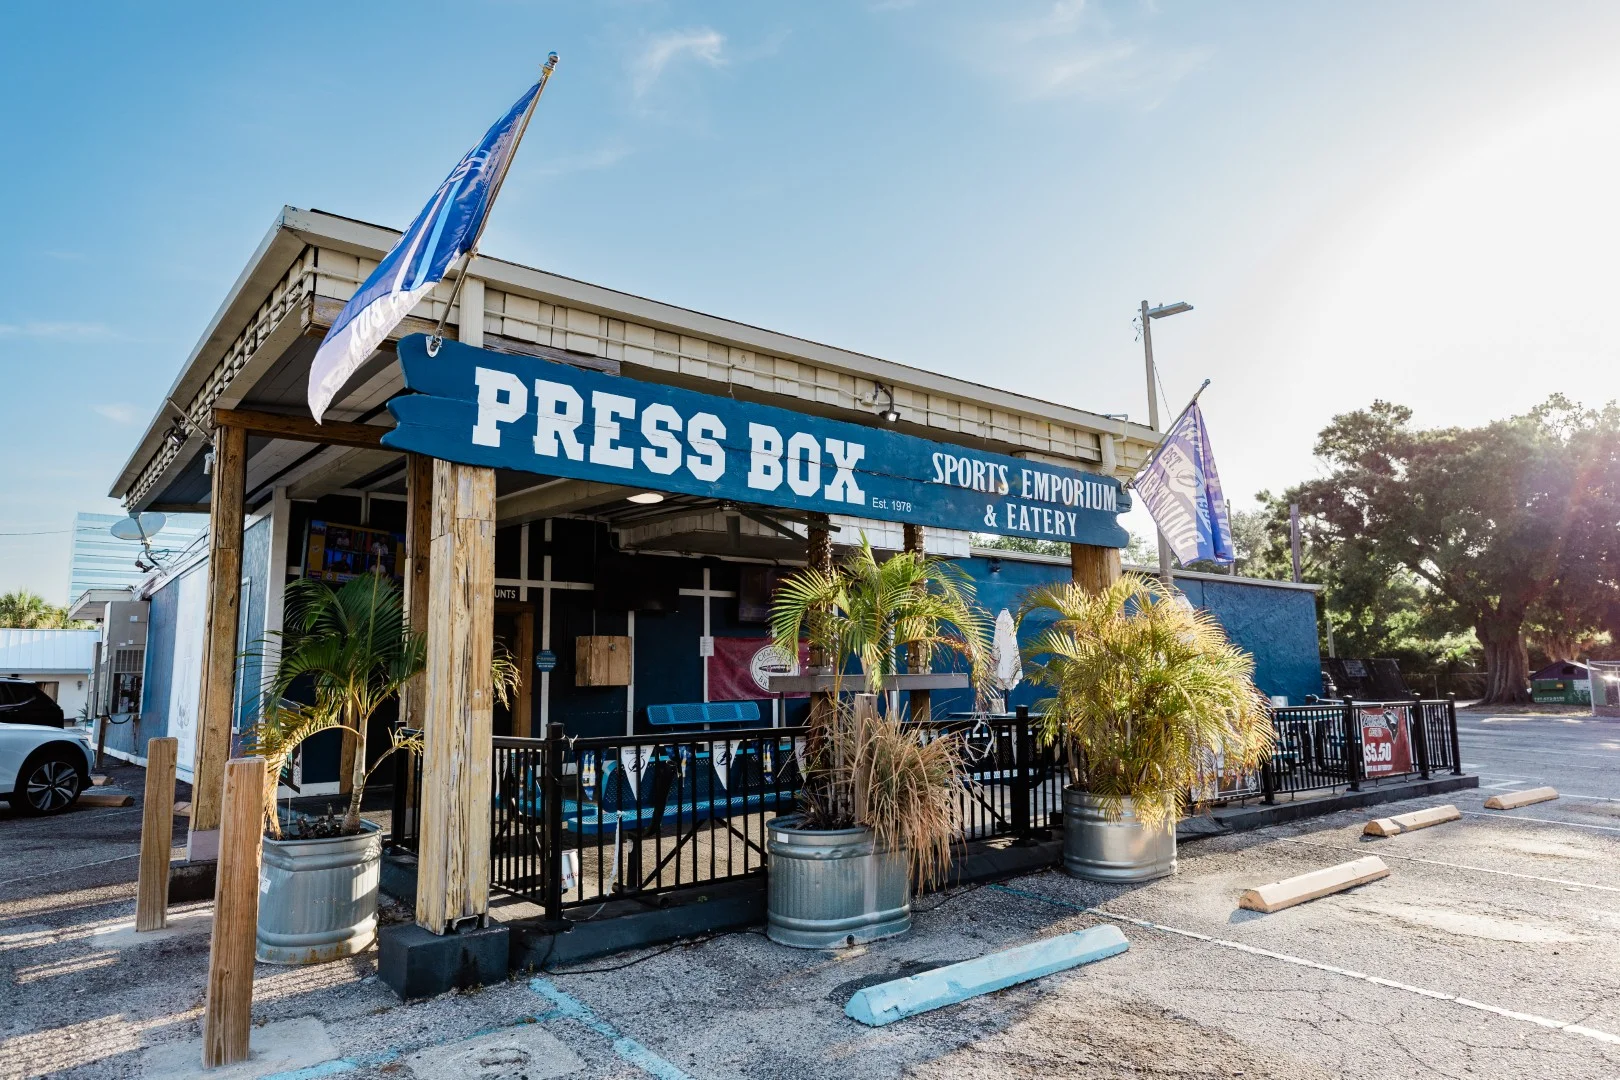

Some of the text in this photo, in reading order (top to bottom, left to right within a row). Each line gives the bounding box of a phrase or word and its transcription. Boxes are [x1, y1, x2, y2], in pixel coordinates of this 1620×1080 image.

[471, 366, 866, 505] PRESS BOX
[932, 452, 1117, 512] SPORTS EMPORIUM
[872, 497, 912, 513] Est. 1978
[984, 503, 1077, 537] & EATERY
[494, 589, 516, 599] UNTS
[1365, 742, 1392, 763] $5.50
